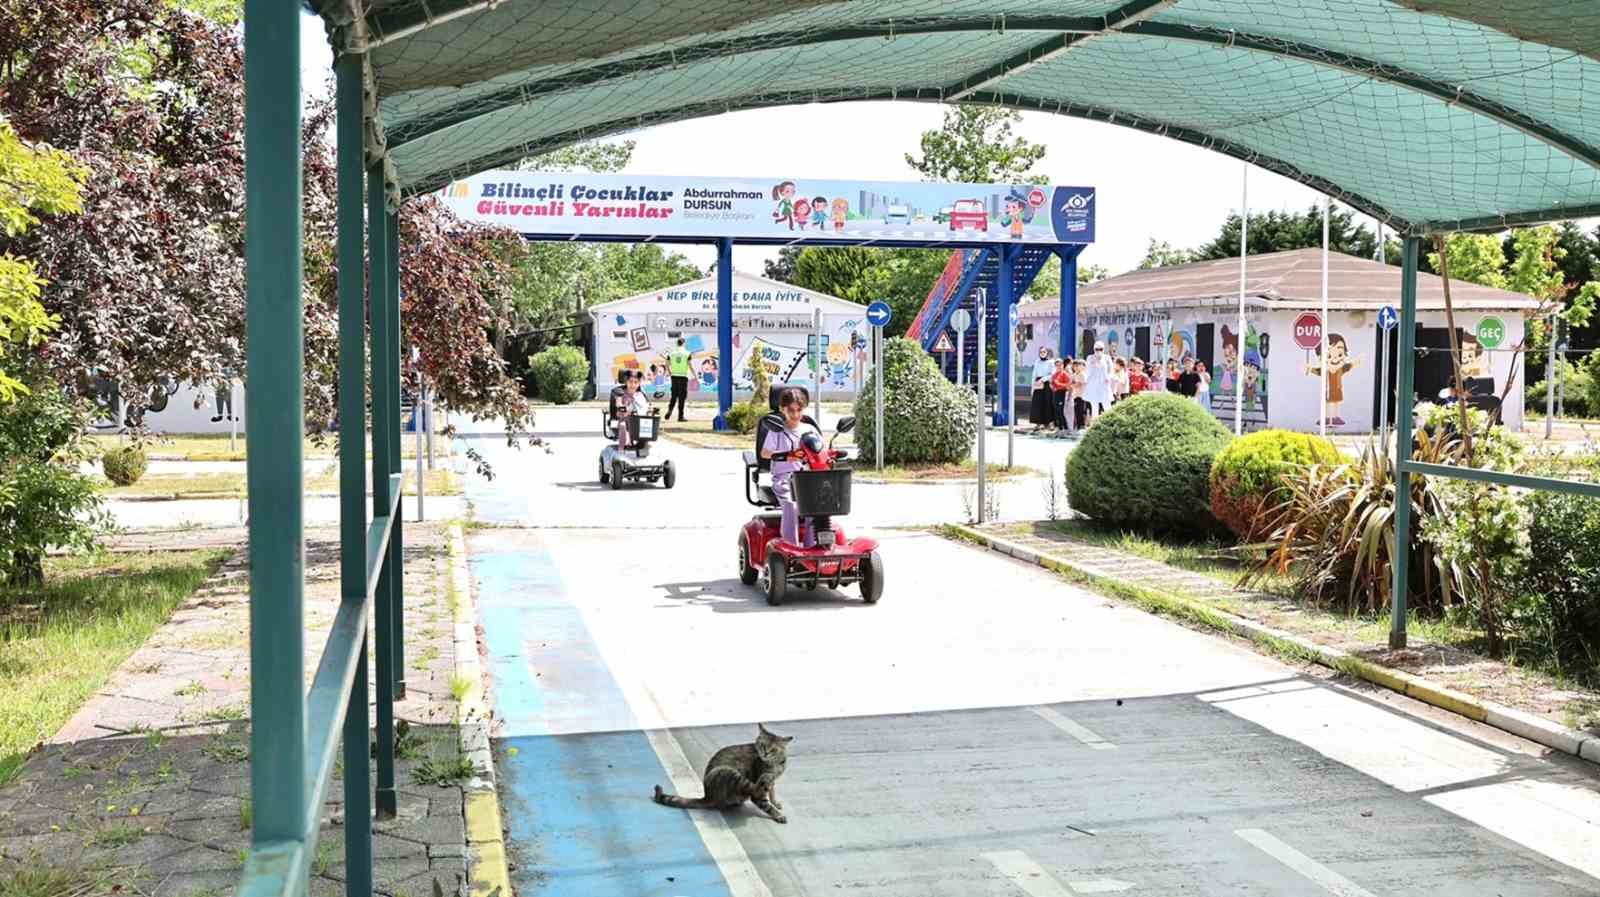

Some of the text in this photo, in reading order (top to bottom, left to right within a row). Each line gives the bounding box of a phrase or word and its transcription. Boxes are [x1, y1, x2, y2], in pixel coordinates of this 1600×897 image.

[481, 183, 674, 201] Bilinçli Çocuklar
[683, 188, 763, 199] Abdurrahman
[477, 200, 674, 218] Güvenli Yarınlar
[684, 200, 732, 210] DURSUN
[667, 291, 688, 301] HEP
[743, 292, 771, 302] DAHA
[775, 290, 802, 302] İYİYE
[1296, 325, 1321, 337] DUR
[1480, 327, 1501, 341] GEÇ
